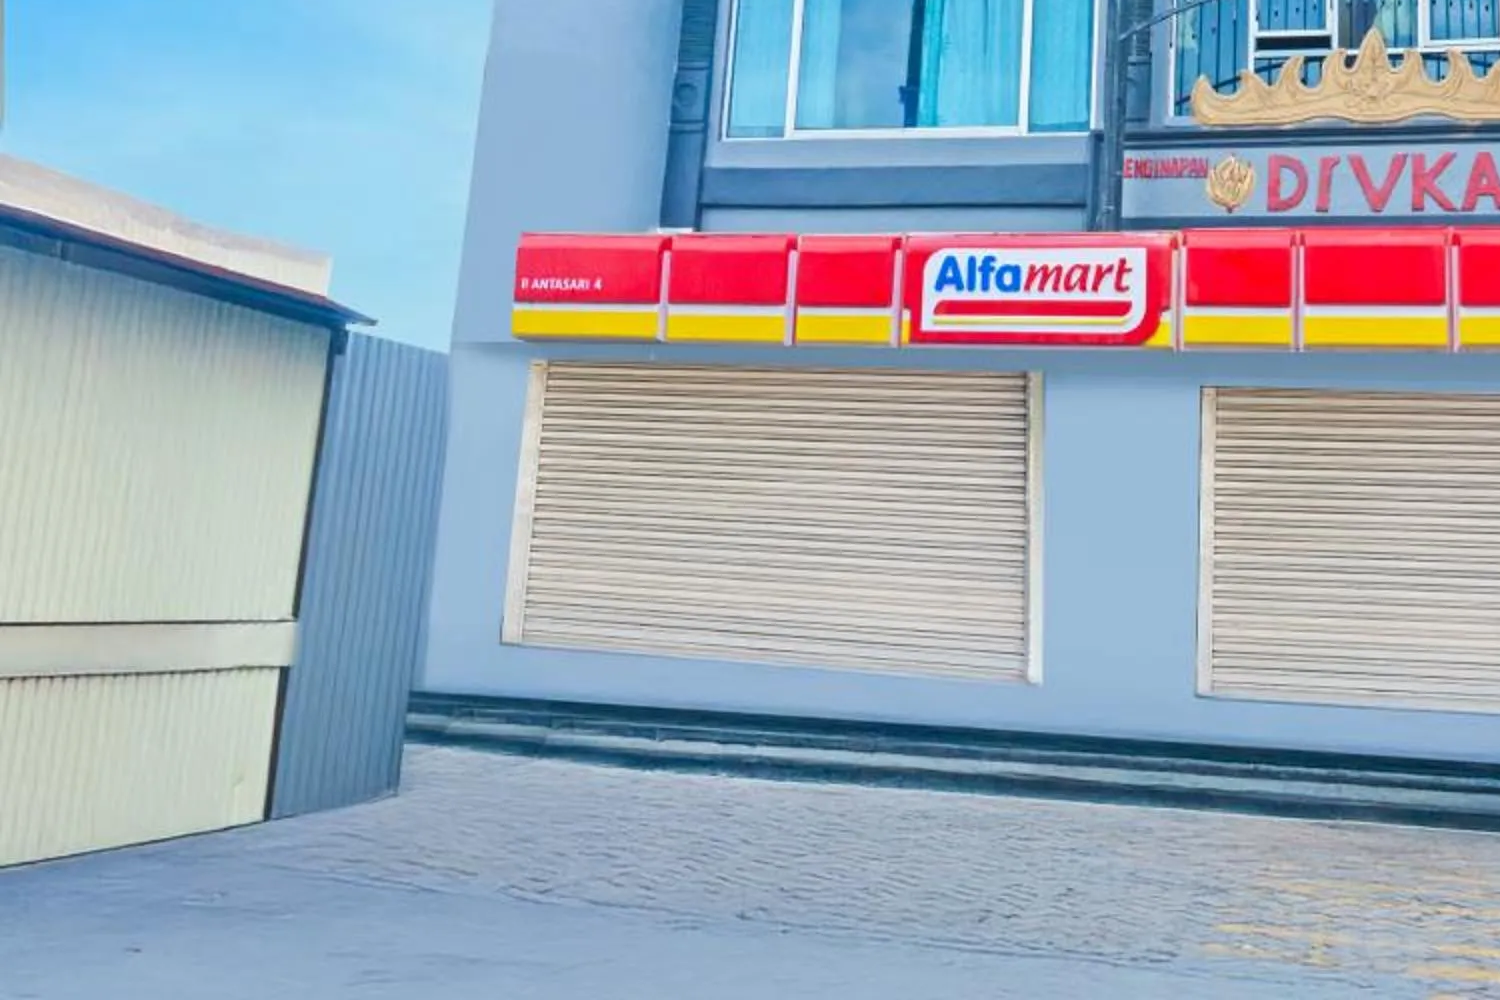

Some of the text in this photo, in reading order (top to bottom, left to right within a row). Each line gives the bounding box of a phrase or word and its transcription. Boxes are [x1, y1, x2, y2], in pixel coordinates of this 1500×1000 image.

[1123, 156, 1209, 179] ENGINAPAN
[531, 277, 591, 291] ANTASARI
[593, 276, 603, 291] 4
[934, 255, 1133, 293] Alfamart
